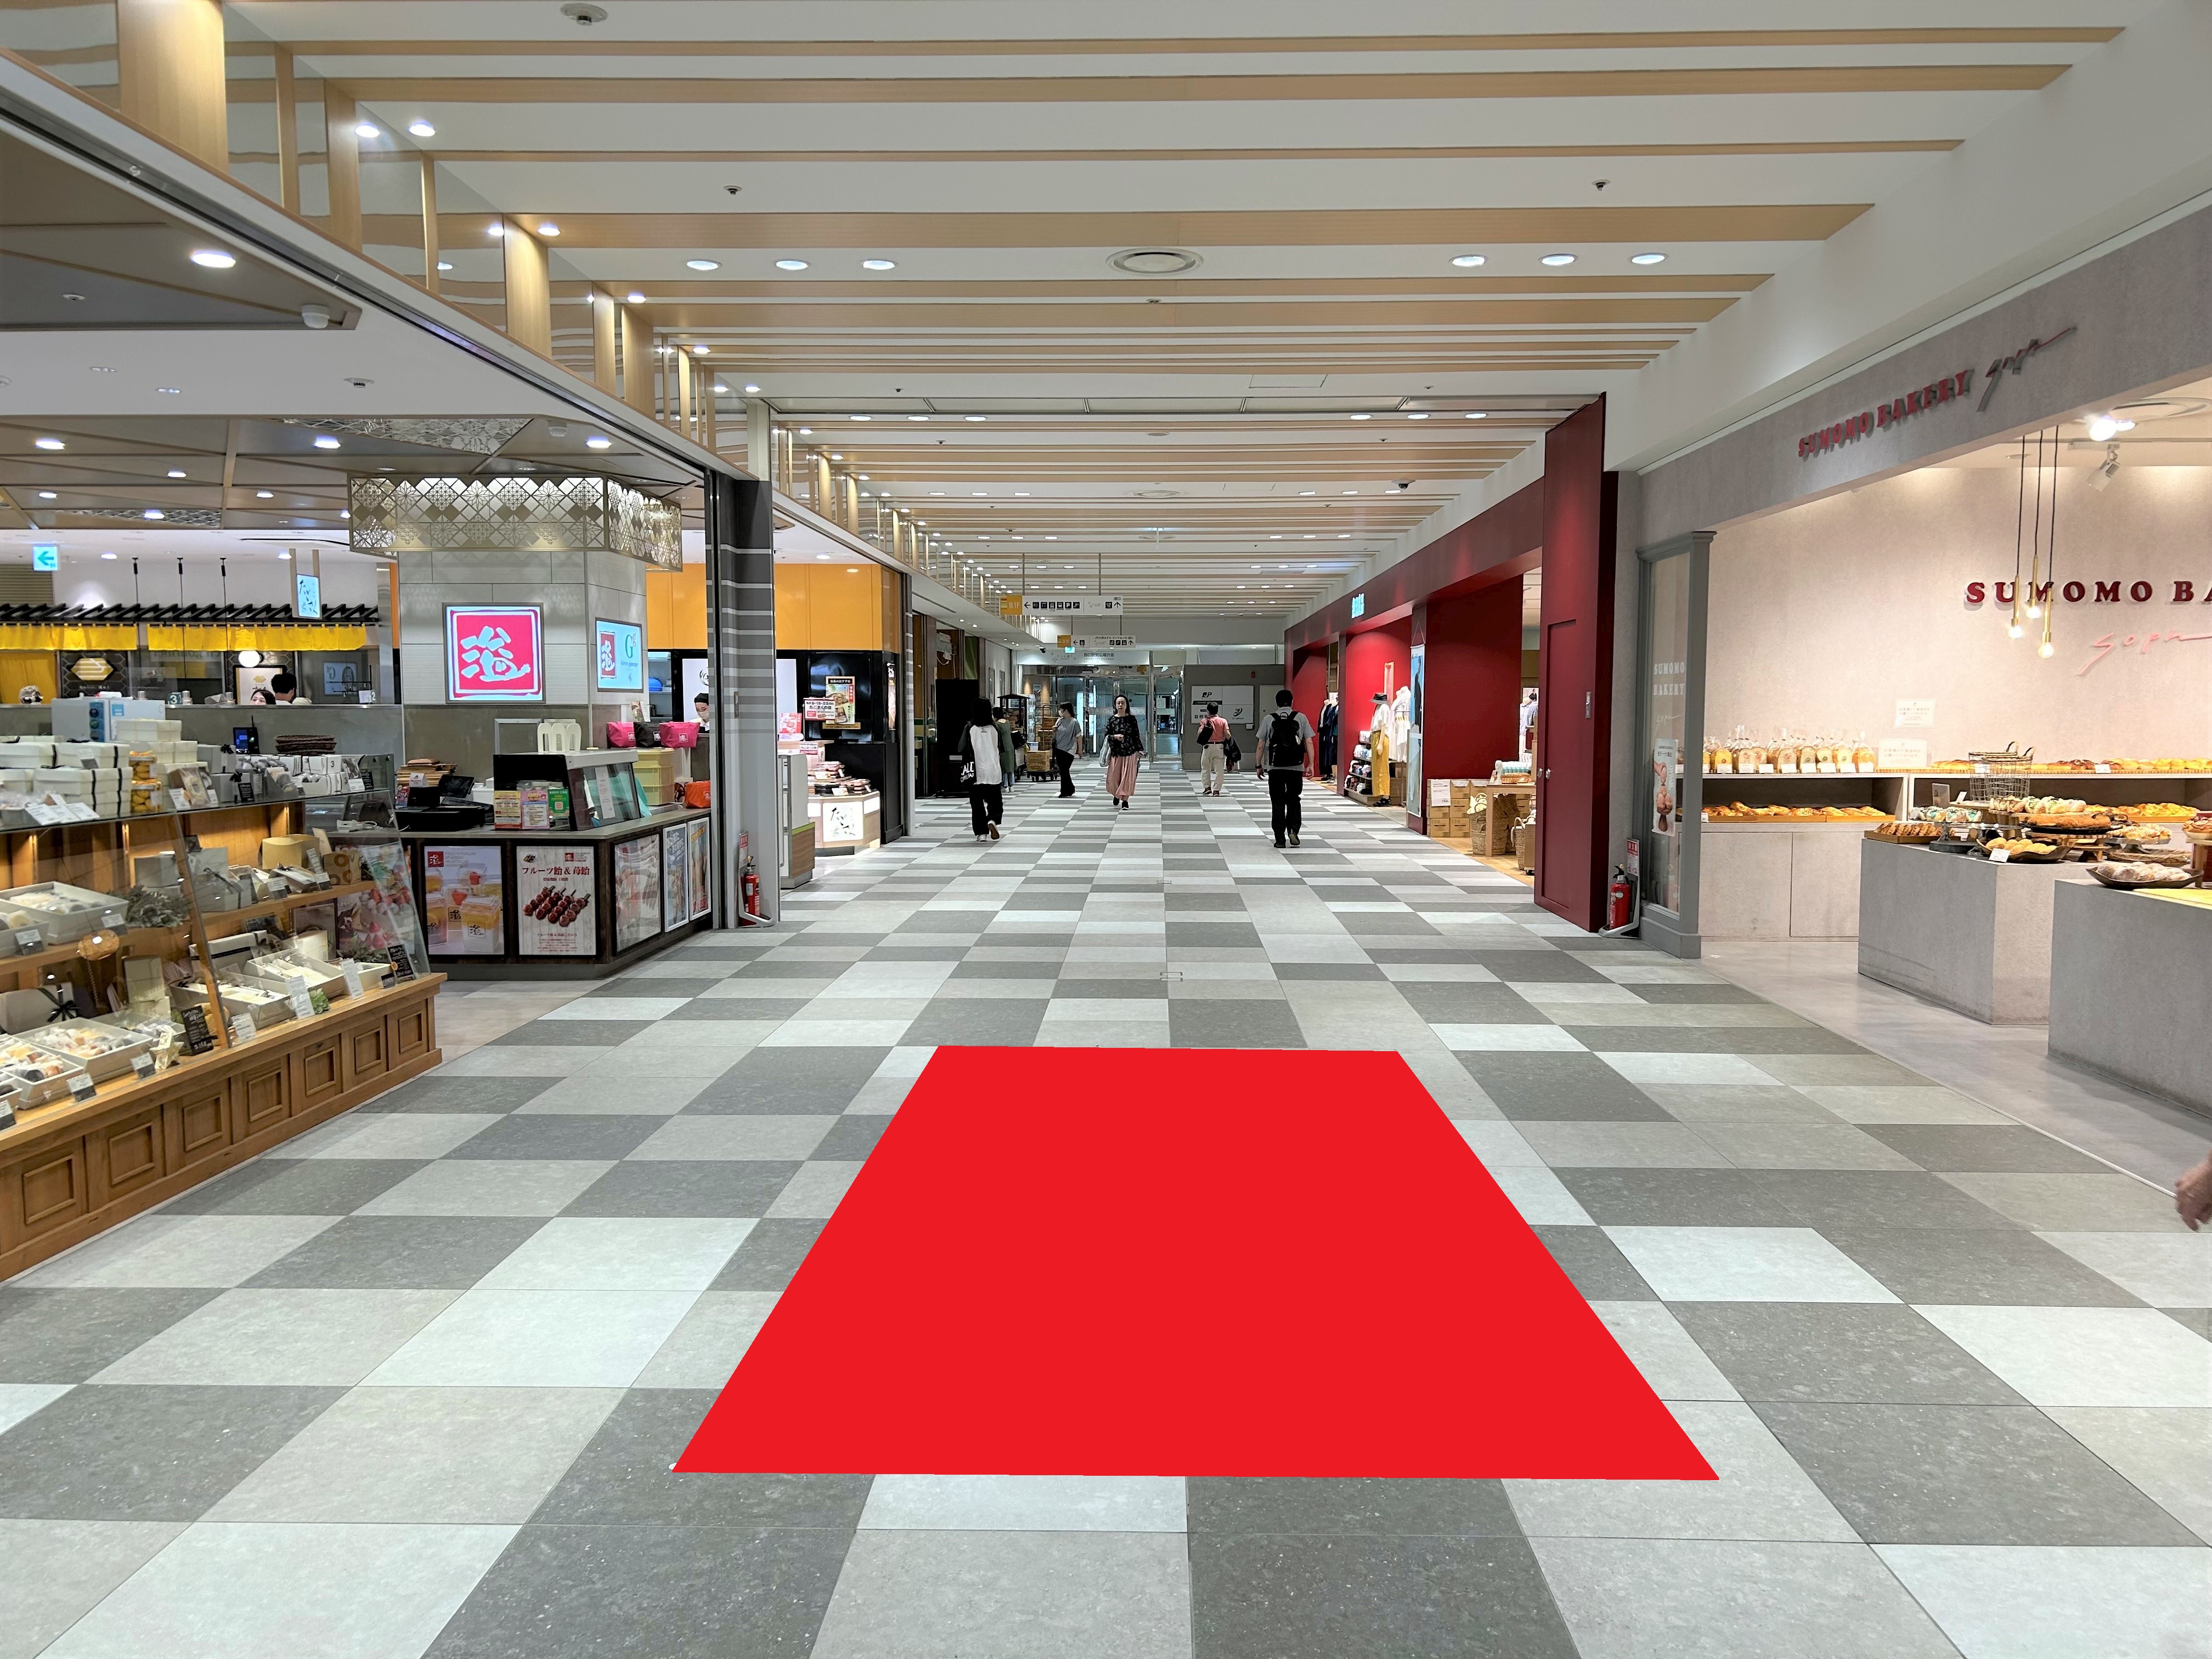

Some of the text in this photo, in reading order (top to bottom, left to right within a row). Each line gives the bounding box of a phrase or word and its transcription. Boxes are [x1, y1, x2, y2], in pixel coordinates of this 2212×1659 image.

[1799, 413, 1870, 457] SUMOMO
[1877, 370, 1973, 428] BAKERY
[1967, 580, 2153, 603] SUMOMO
[1654, 662, 1685, 675] SUMOMO
[1654, 683, 1685, 696] BAKERY
[170, 695, 177, 704] 3
[522, 866, 562, 875] フルーツ飴
[564, 867, 571, 875] &
